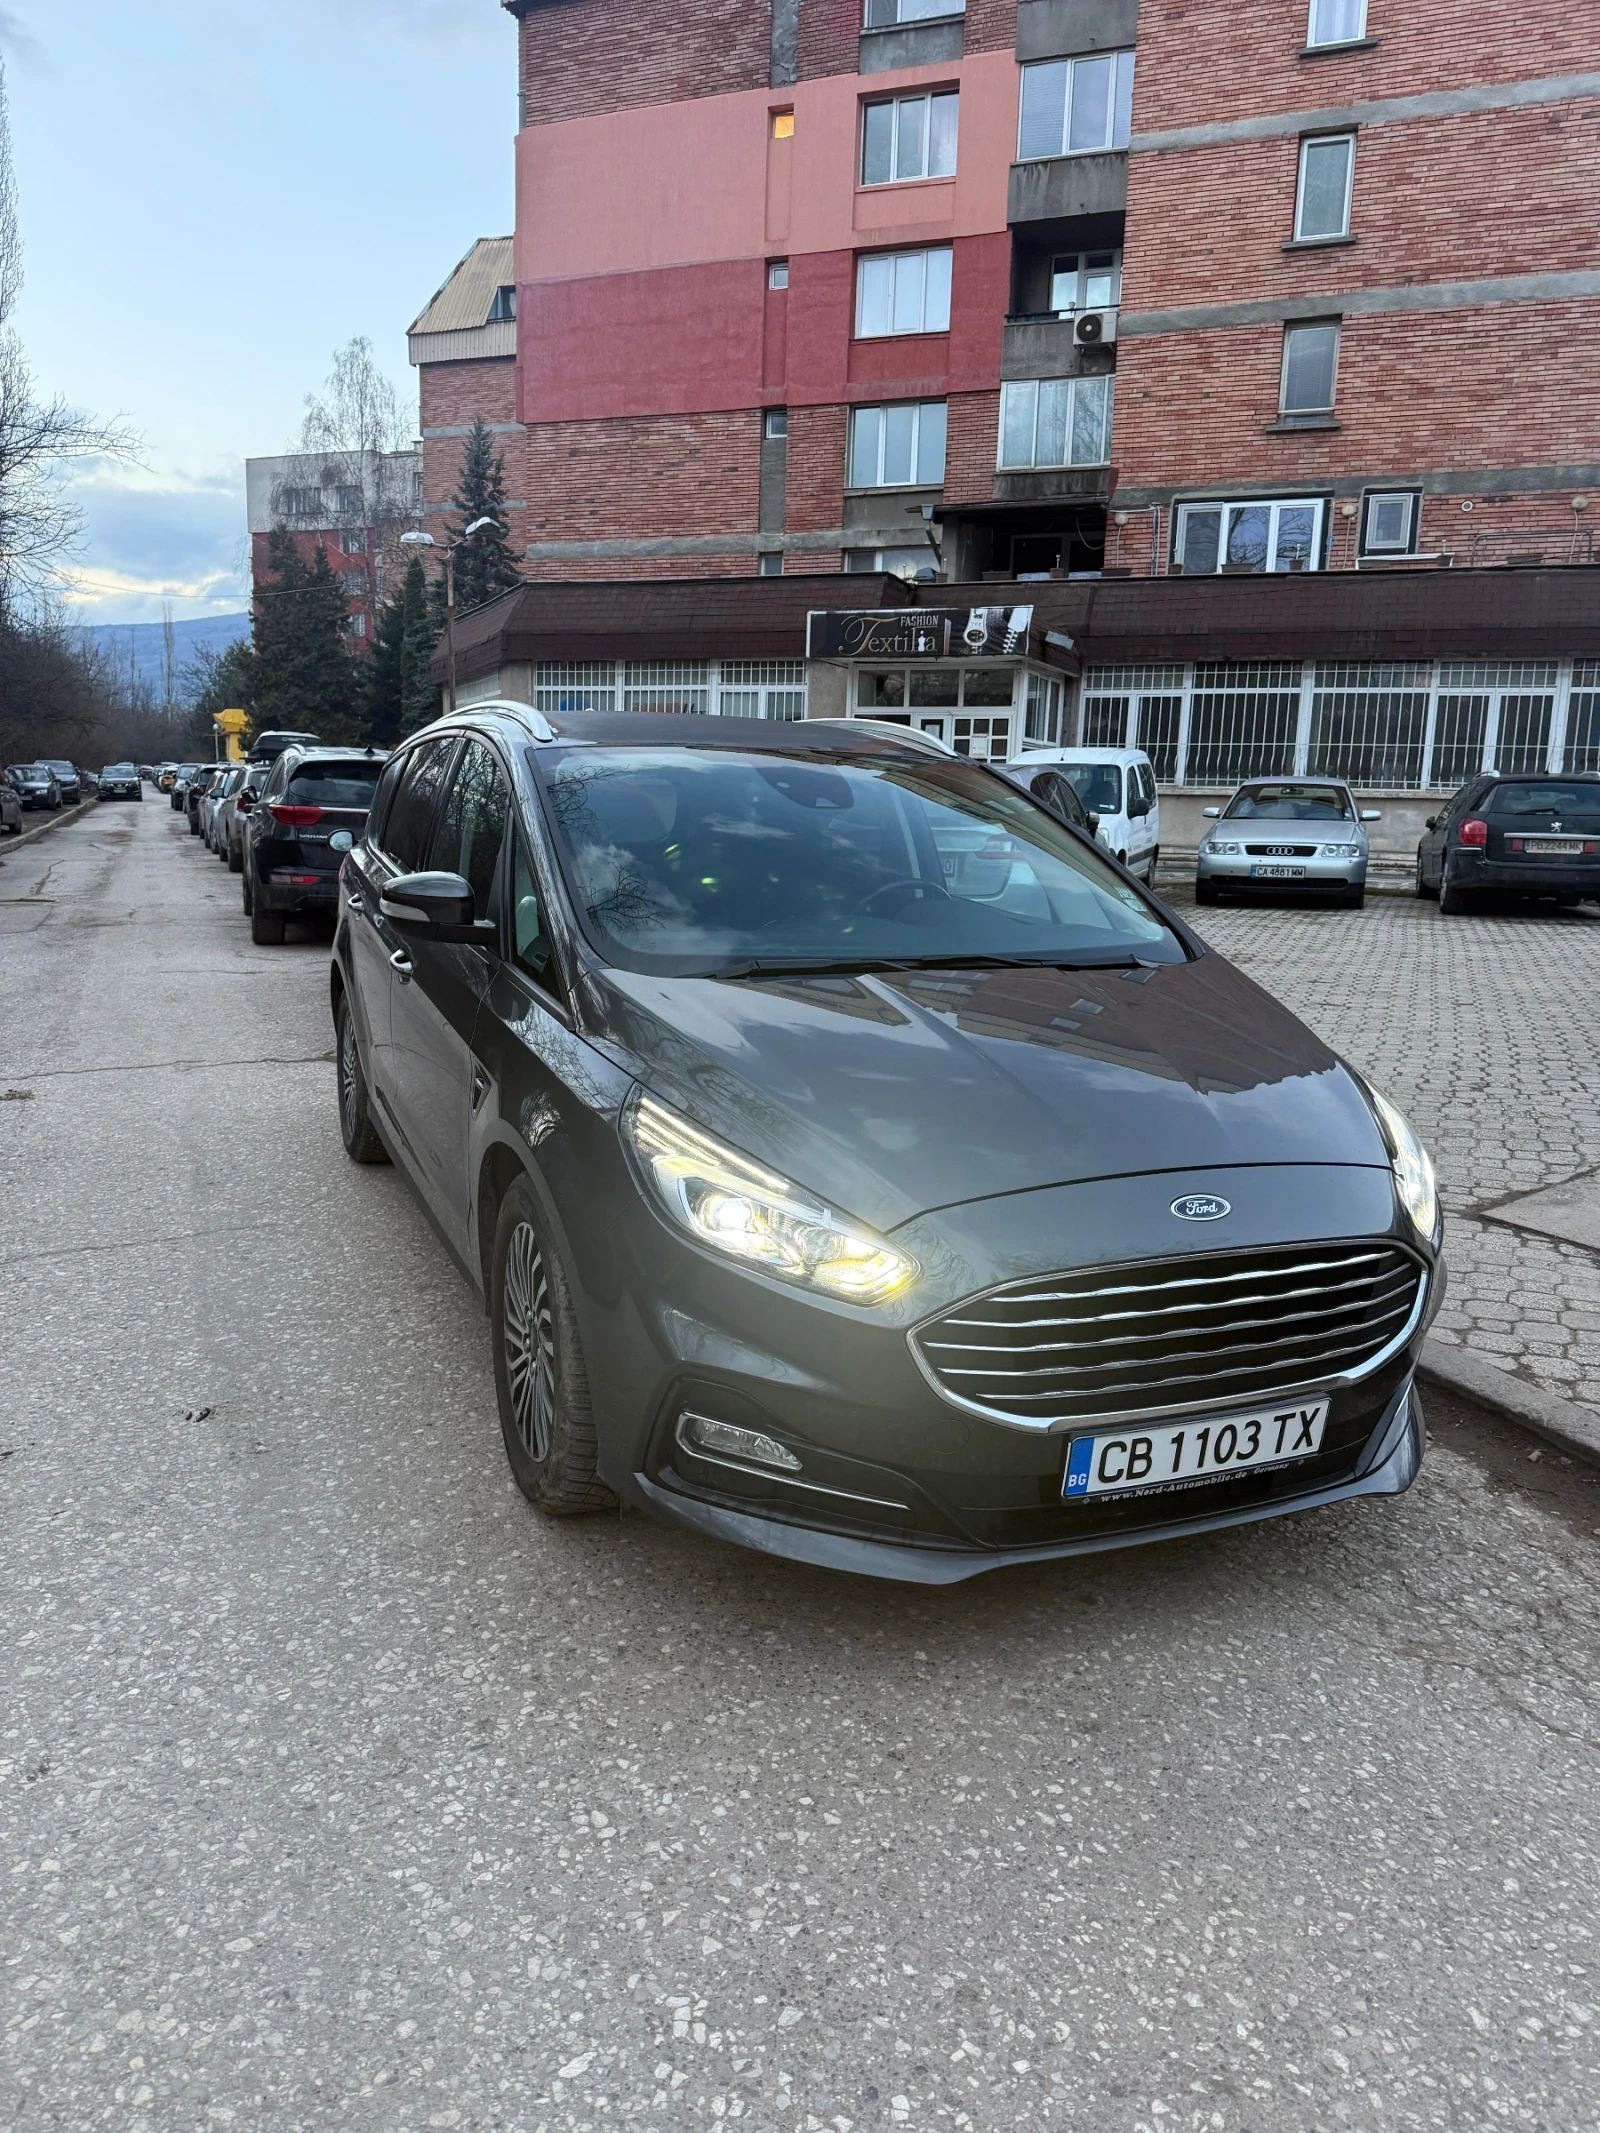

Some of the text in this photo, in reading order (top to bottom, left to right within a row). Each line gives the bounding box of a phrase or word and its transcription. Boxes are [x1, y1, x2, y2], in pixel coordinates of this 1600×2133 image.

[900, 614, 939, 628] FASHION
[838, 615, 937, 656] Textilia
[1256, 867, 1268, 876] CA
[1269, 867, 1290, 877] 4881
[1186, 1199, 1218, 1215] Ford
[1097, 1406, 1321, 1484] CB 1103 TX
[1253, 1462, 1290, 1475] Germany
[1067, 1473, 1087, 1488] BG
